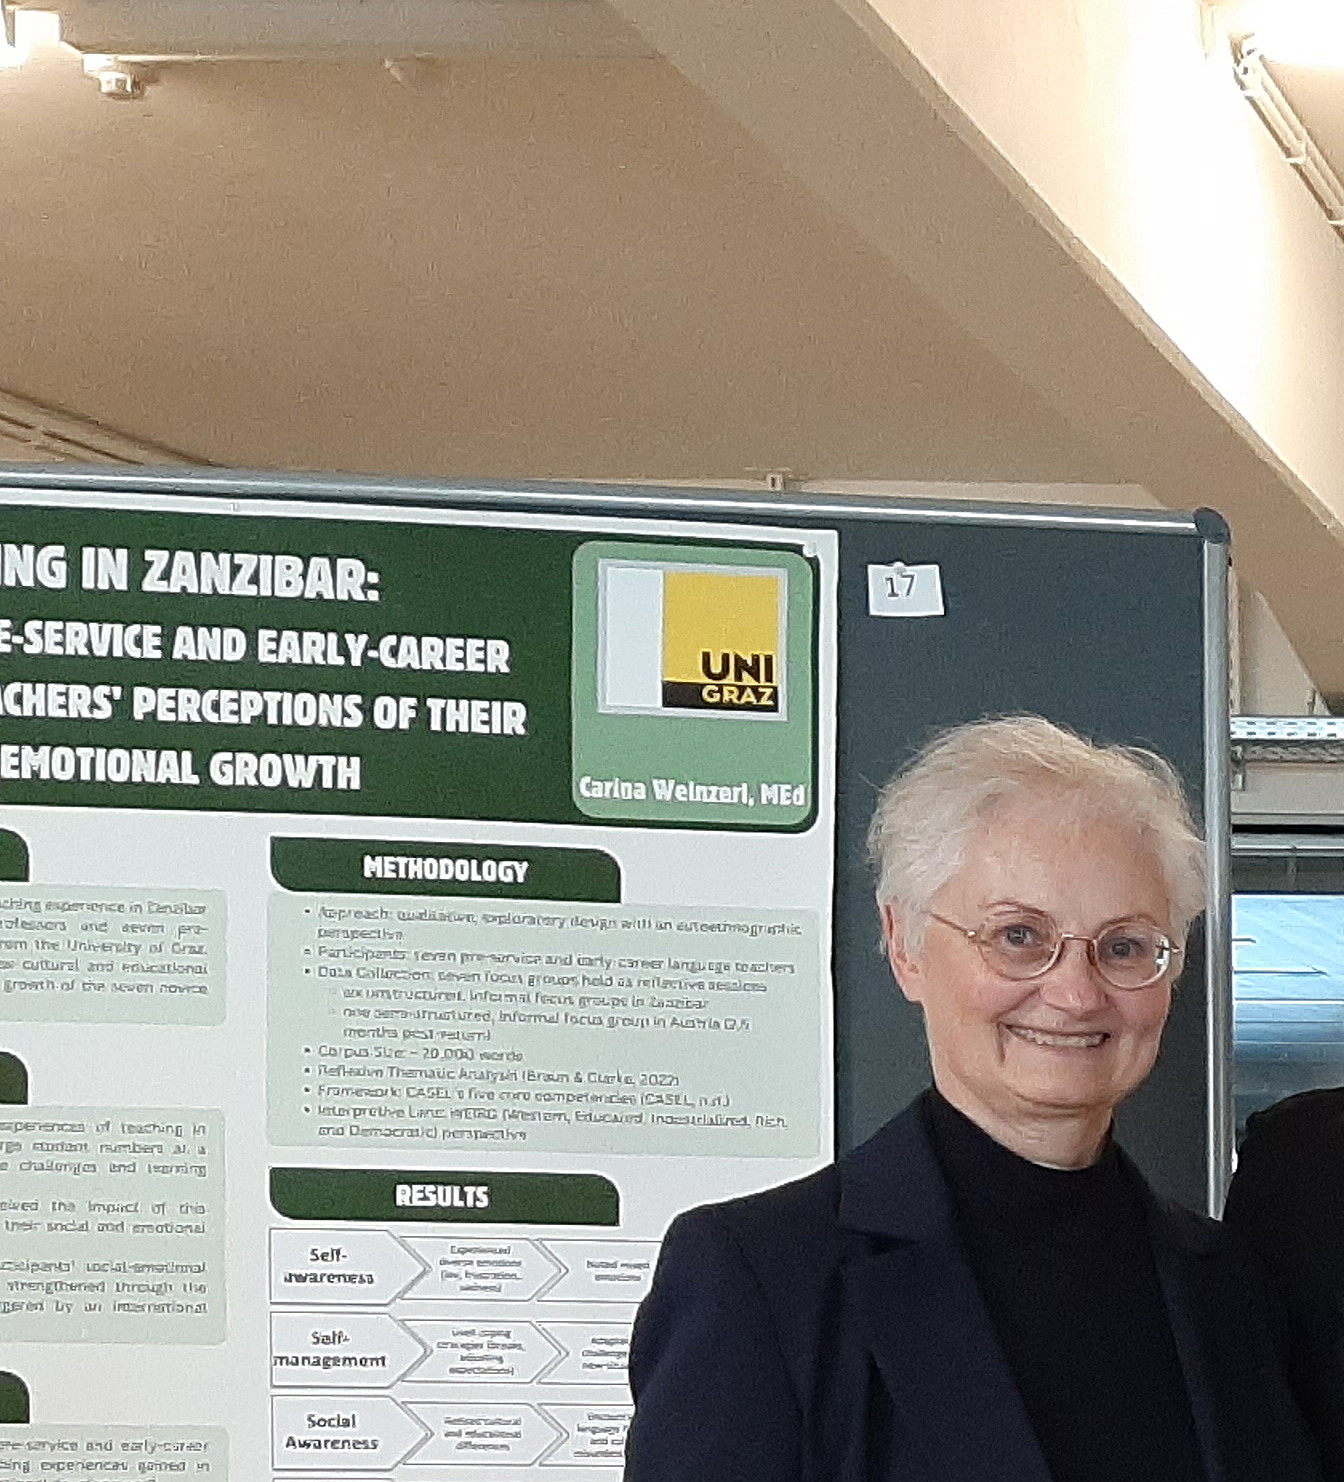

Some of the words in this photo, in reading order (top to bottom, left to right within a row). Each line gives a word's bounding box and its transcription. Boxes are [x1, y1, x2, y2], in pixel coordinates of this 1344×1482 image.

[82, 547, 128, 591] IN
[142, 549, 381, 602] ZANZIBAR:
[884, 574, 916, 598] 17
[0, 618, 162, 659] E-SERVICE
[172, 626, 246, 661] AND
[258, 631, 511, 673] EARLY-CAREER
[702, 651, 774, 684] UNI
[0, 682, 122, 719] CHERS'
[132, 687, 364, 729] PERCEPTIONS
[374, 696, 418, 731] OF
[426, 698, 529, 736] THEIR
[702, 685, 774, 705] GRAZ
[0, 744, 199, 785] EMOTIONAL
[210, 752, 361, 790] GROWTH
[579, 776, 646, 800] Carina
[652, 778, 755, 807] Weinzerl,
[760, 783, 805, 806] MEd
[363, 855, 529, 883] METHODOLOGY
[395, 1184, 489, 1209] RESULTS
[273, 1353, 388, 1370] management
[306, 1413, 356, 1429] Social
[285, 1435, 380, 1451] Awareness
